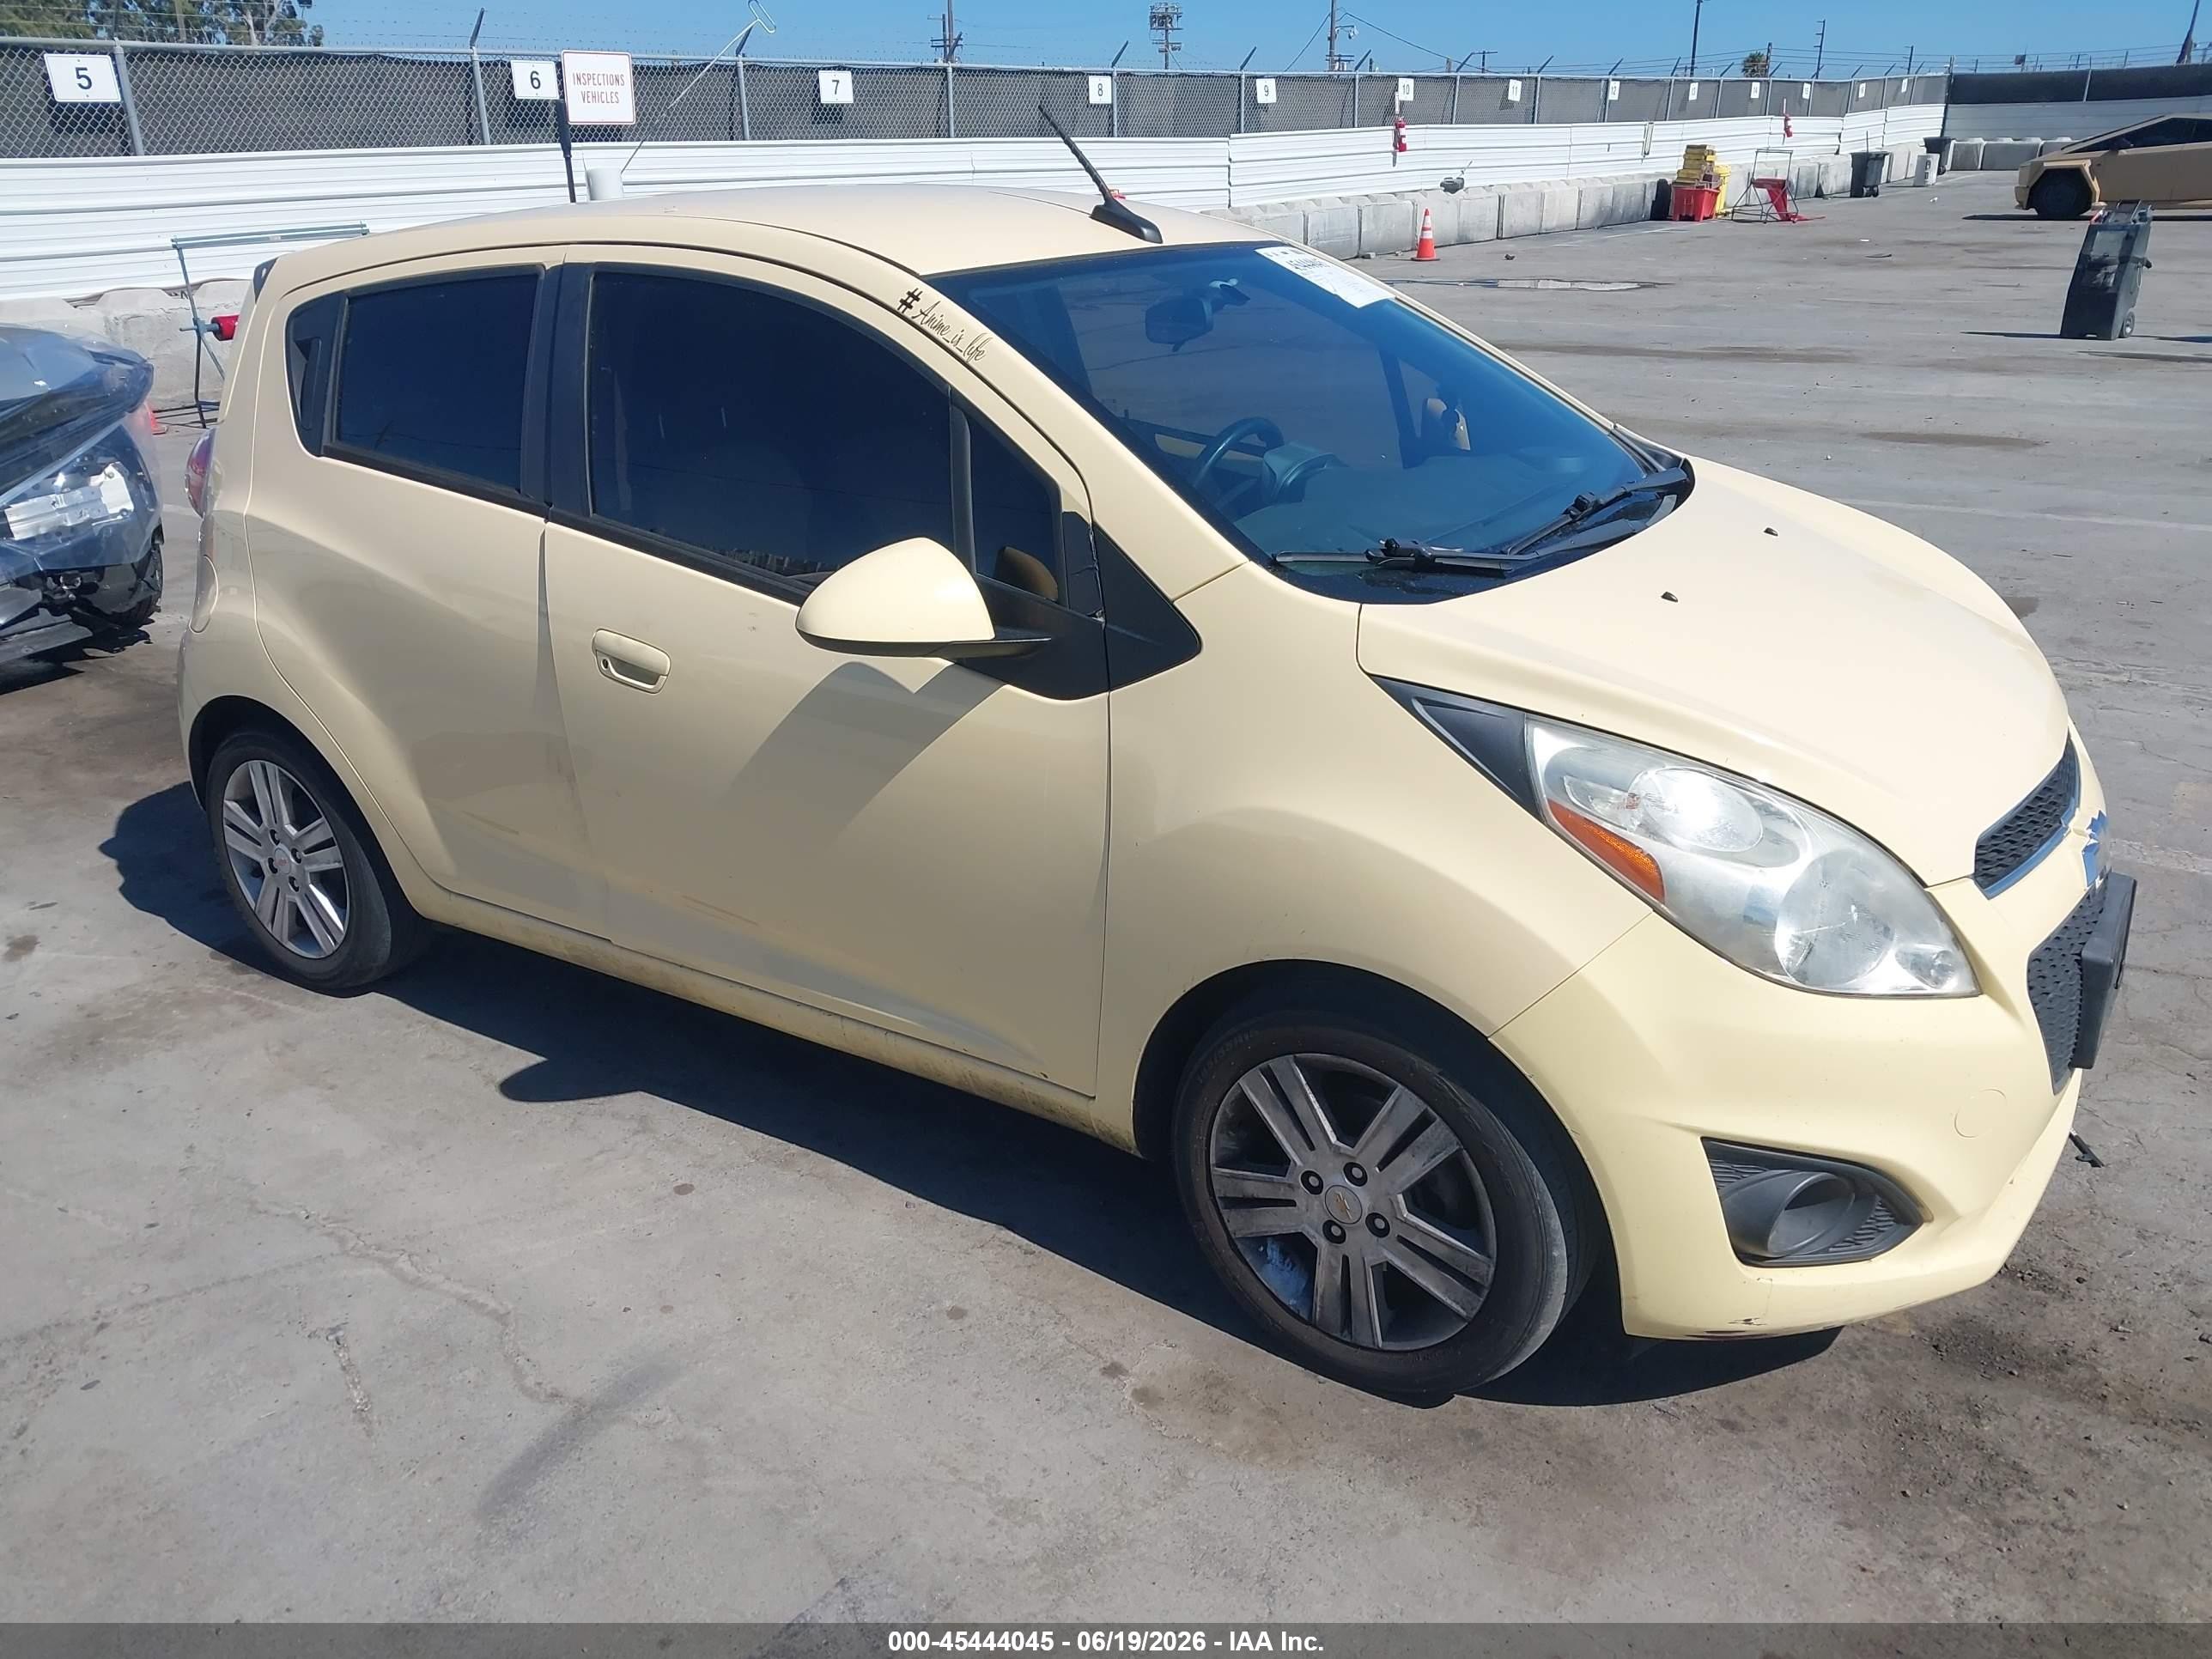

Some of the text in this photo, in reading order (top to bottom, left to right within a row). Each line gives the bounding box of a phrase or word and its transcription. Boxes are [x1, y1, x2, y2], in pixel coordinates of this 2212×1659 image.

[75, 67, 93, 90] 5
[530, 70, 541, 90] 6
[572, 72, 626, 87] INSPECTIONS
[831, 79, 840, 95] 7
[1097, 82, 1103, 97] 8
[1262, 84, 1270, 97] 9
[1402, 83, 1410, 95] 10
[1511, 85, 1518, 97] 11
[580, 90, 620, 104] VEHICLES
